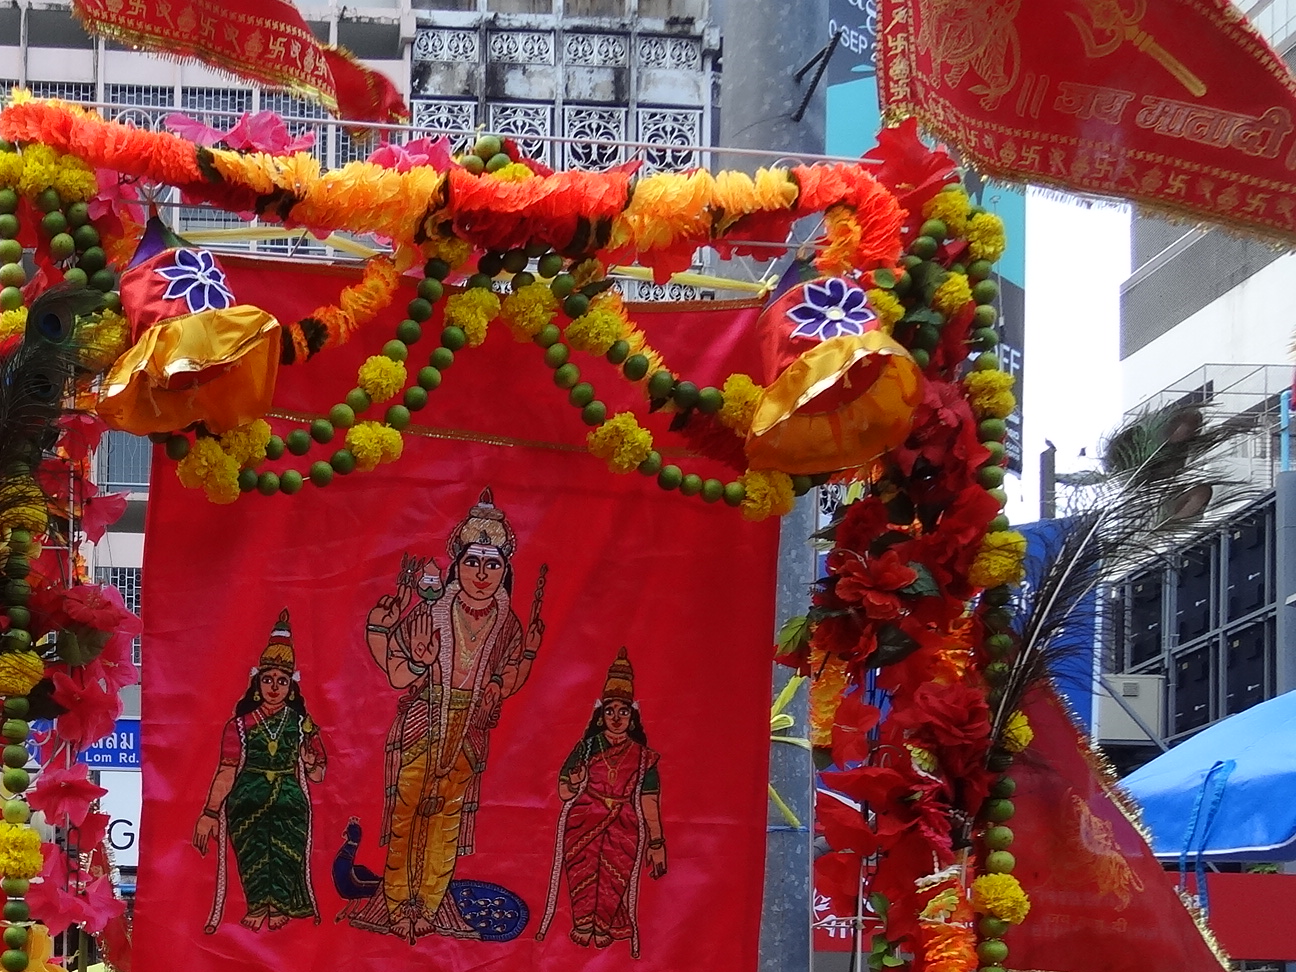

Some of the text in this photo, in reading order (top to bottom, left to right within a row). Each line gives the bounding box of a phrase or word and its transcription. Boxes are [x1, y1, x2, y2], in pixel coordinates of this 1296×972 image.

[840, 25, 868, 54] SEP
[994, 343, 1021, 377] FF
[85, 751, 139, 763] Lom Rd.
